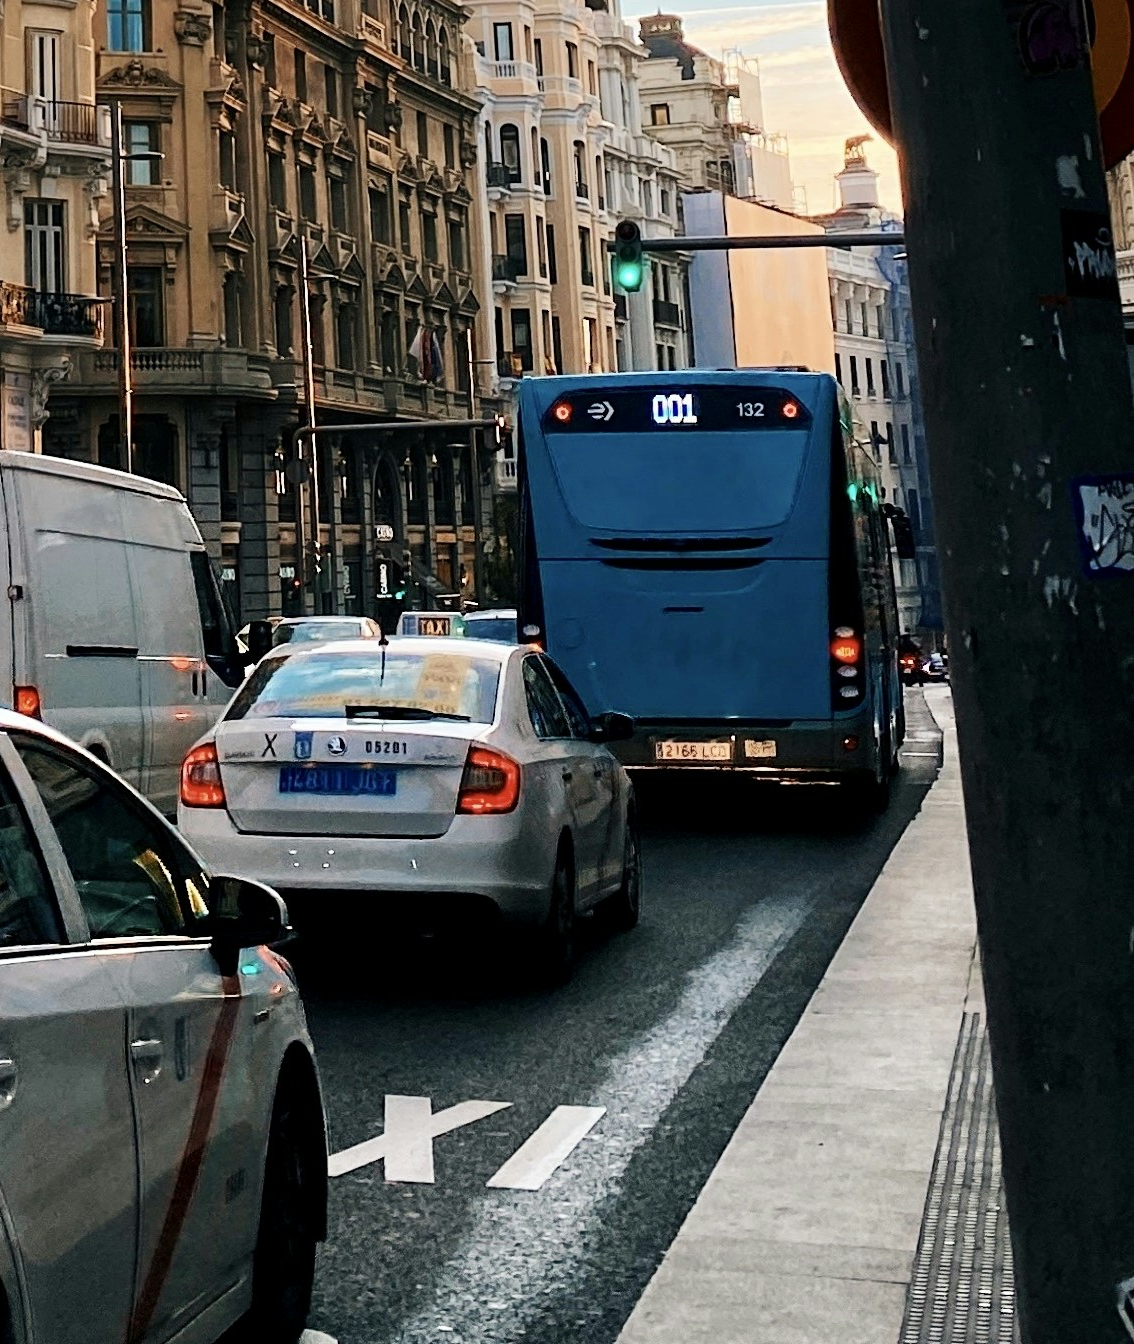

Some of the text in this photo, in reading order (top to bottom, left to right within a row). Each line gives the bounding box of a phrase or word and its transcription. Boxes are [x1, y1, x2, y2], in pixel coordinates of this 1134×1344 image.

[652, 393, 698, 424] 001
[735, 402, 765, 417] 132
[420, 619, 449, 635] TAXI
[261, 733, 278, 758] X
[365, 741, 408, 755] 05201
